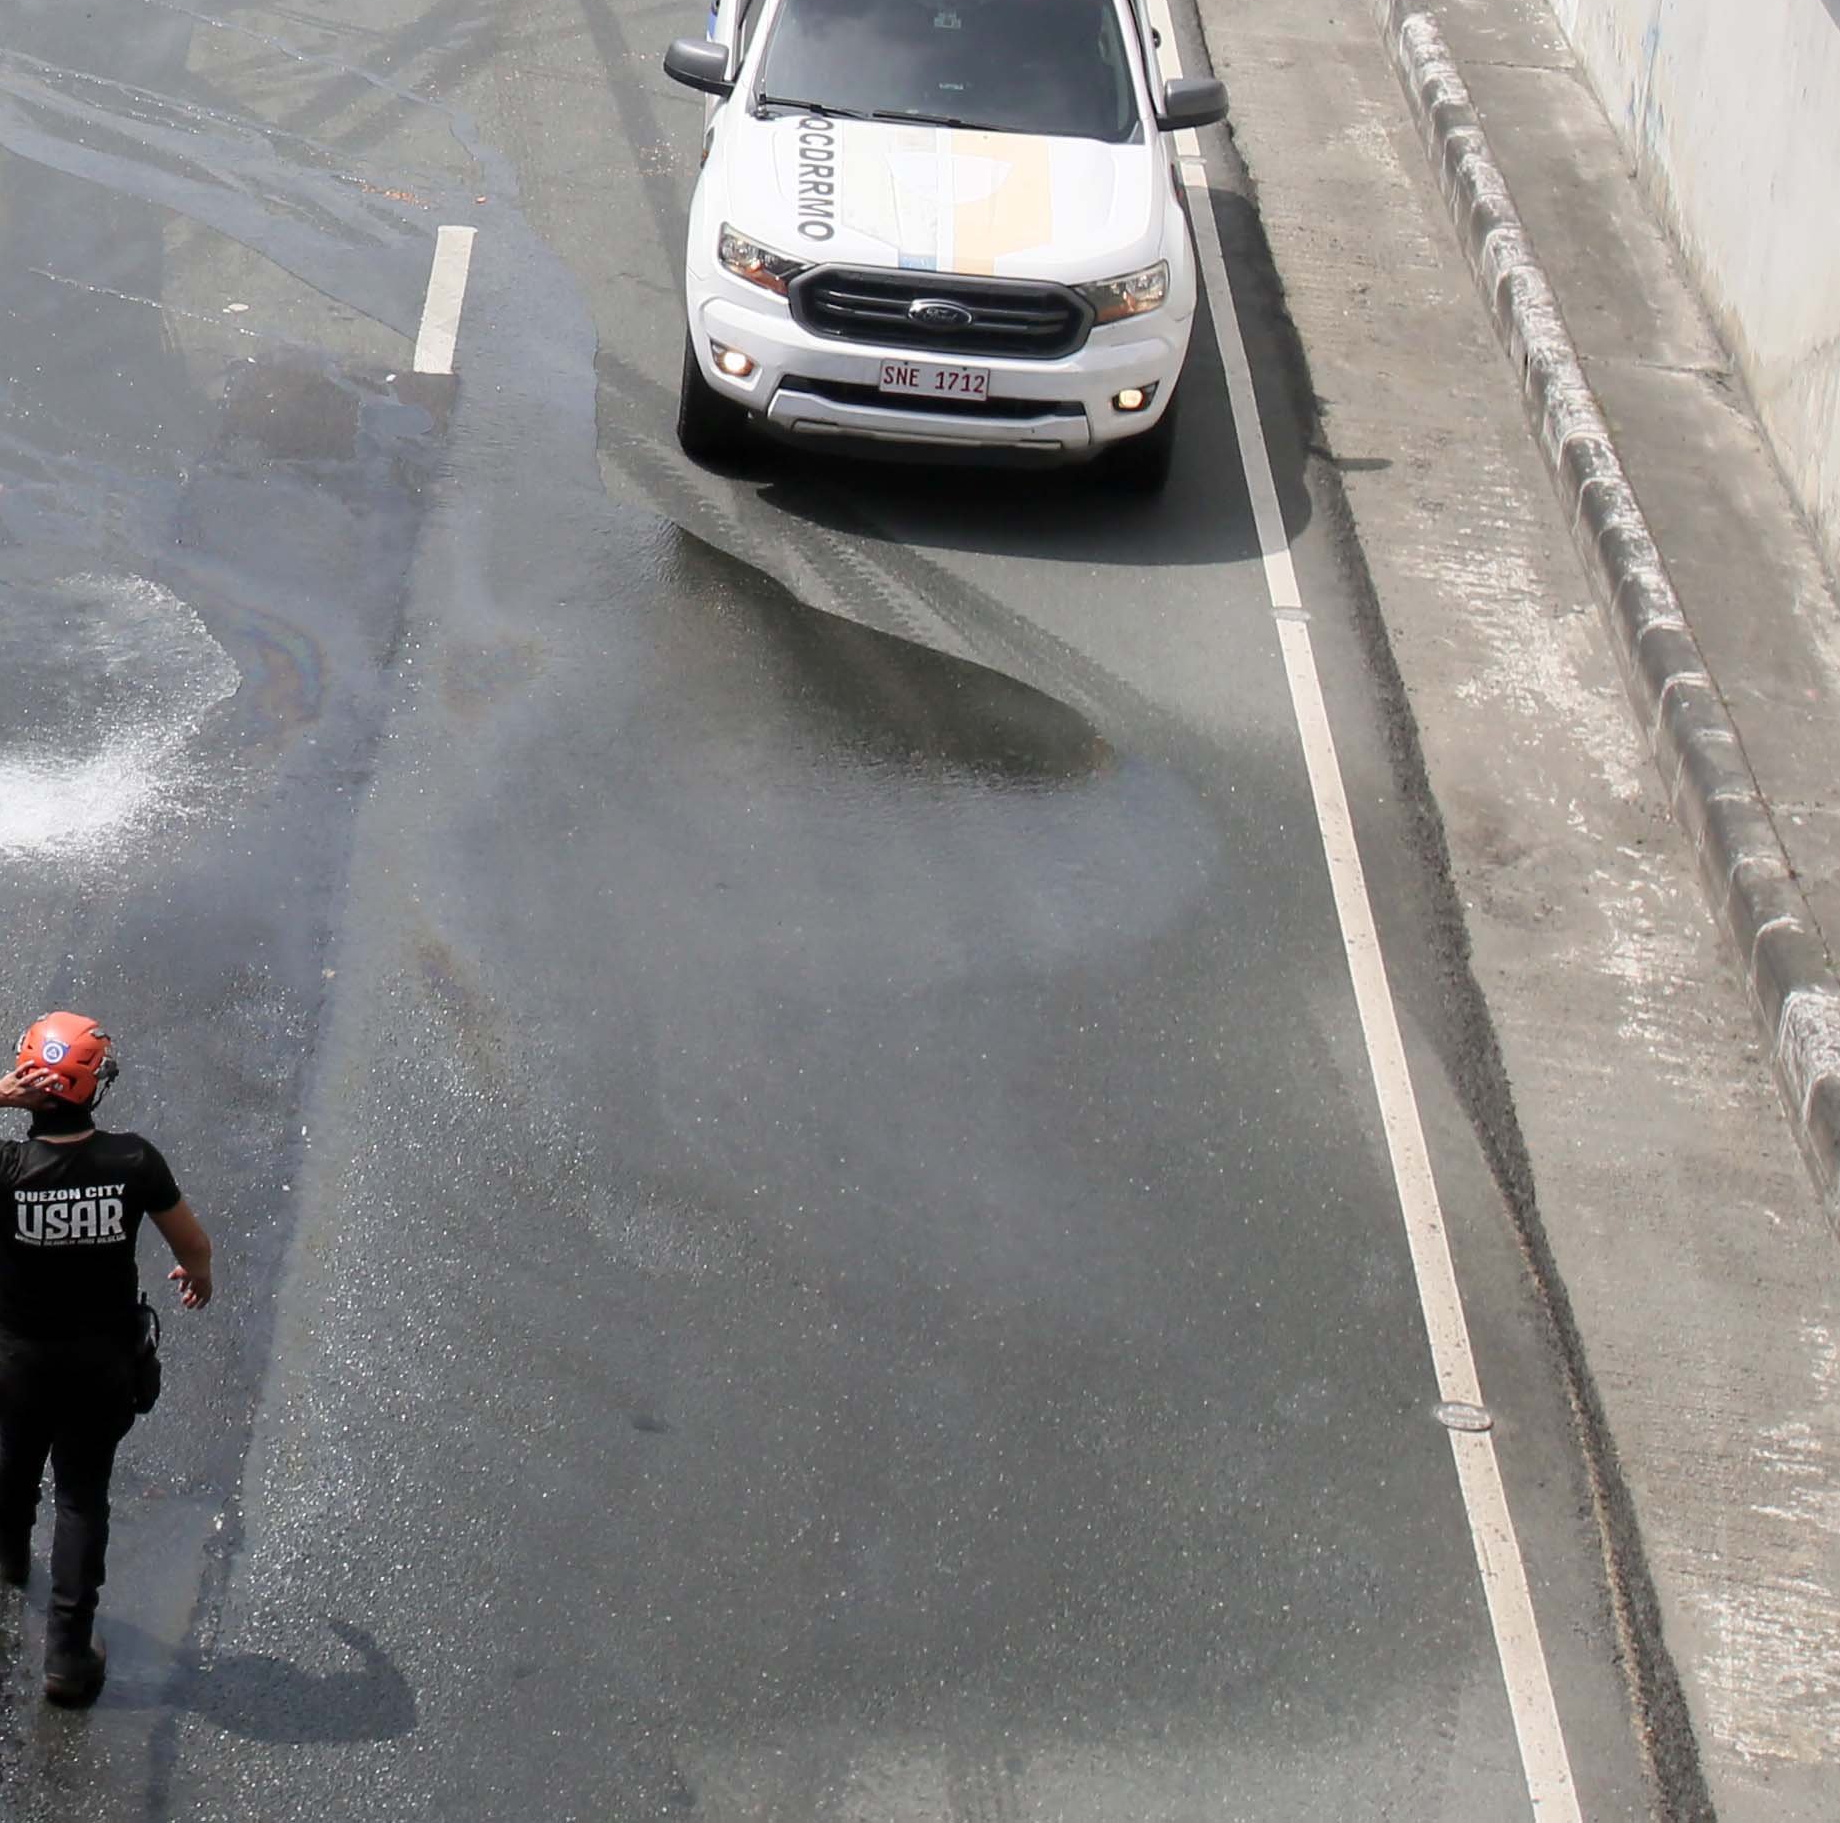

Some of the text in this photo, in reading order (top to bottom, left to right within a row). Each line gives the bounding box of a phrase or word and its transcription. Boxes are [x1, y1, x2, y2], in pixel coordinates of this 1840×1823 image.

[797, 116, 836, 242] QCDRRMO
[882, 364, 986, 395] SNE 1712
[14, 1183, 126, 1203] QUEZON CITY
[17, 1198, 123, 1239] USAR
